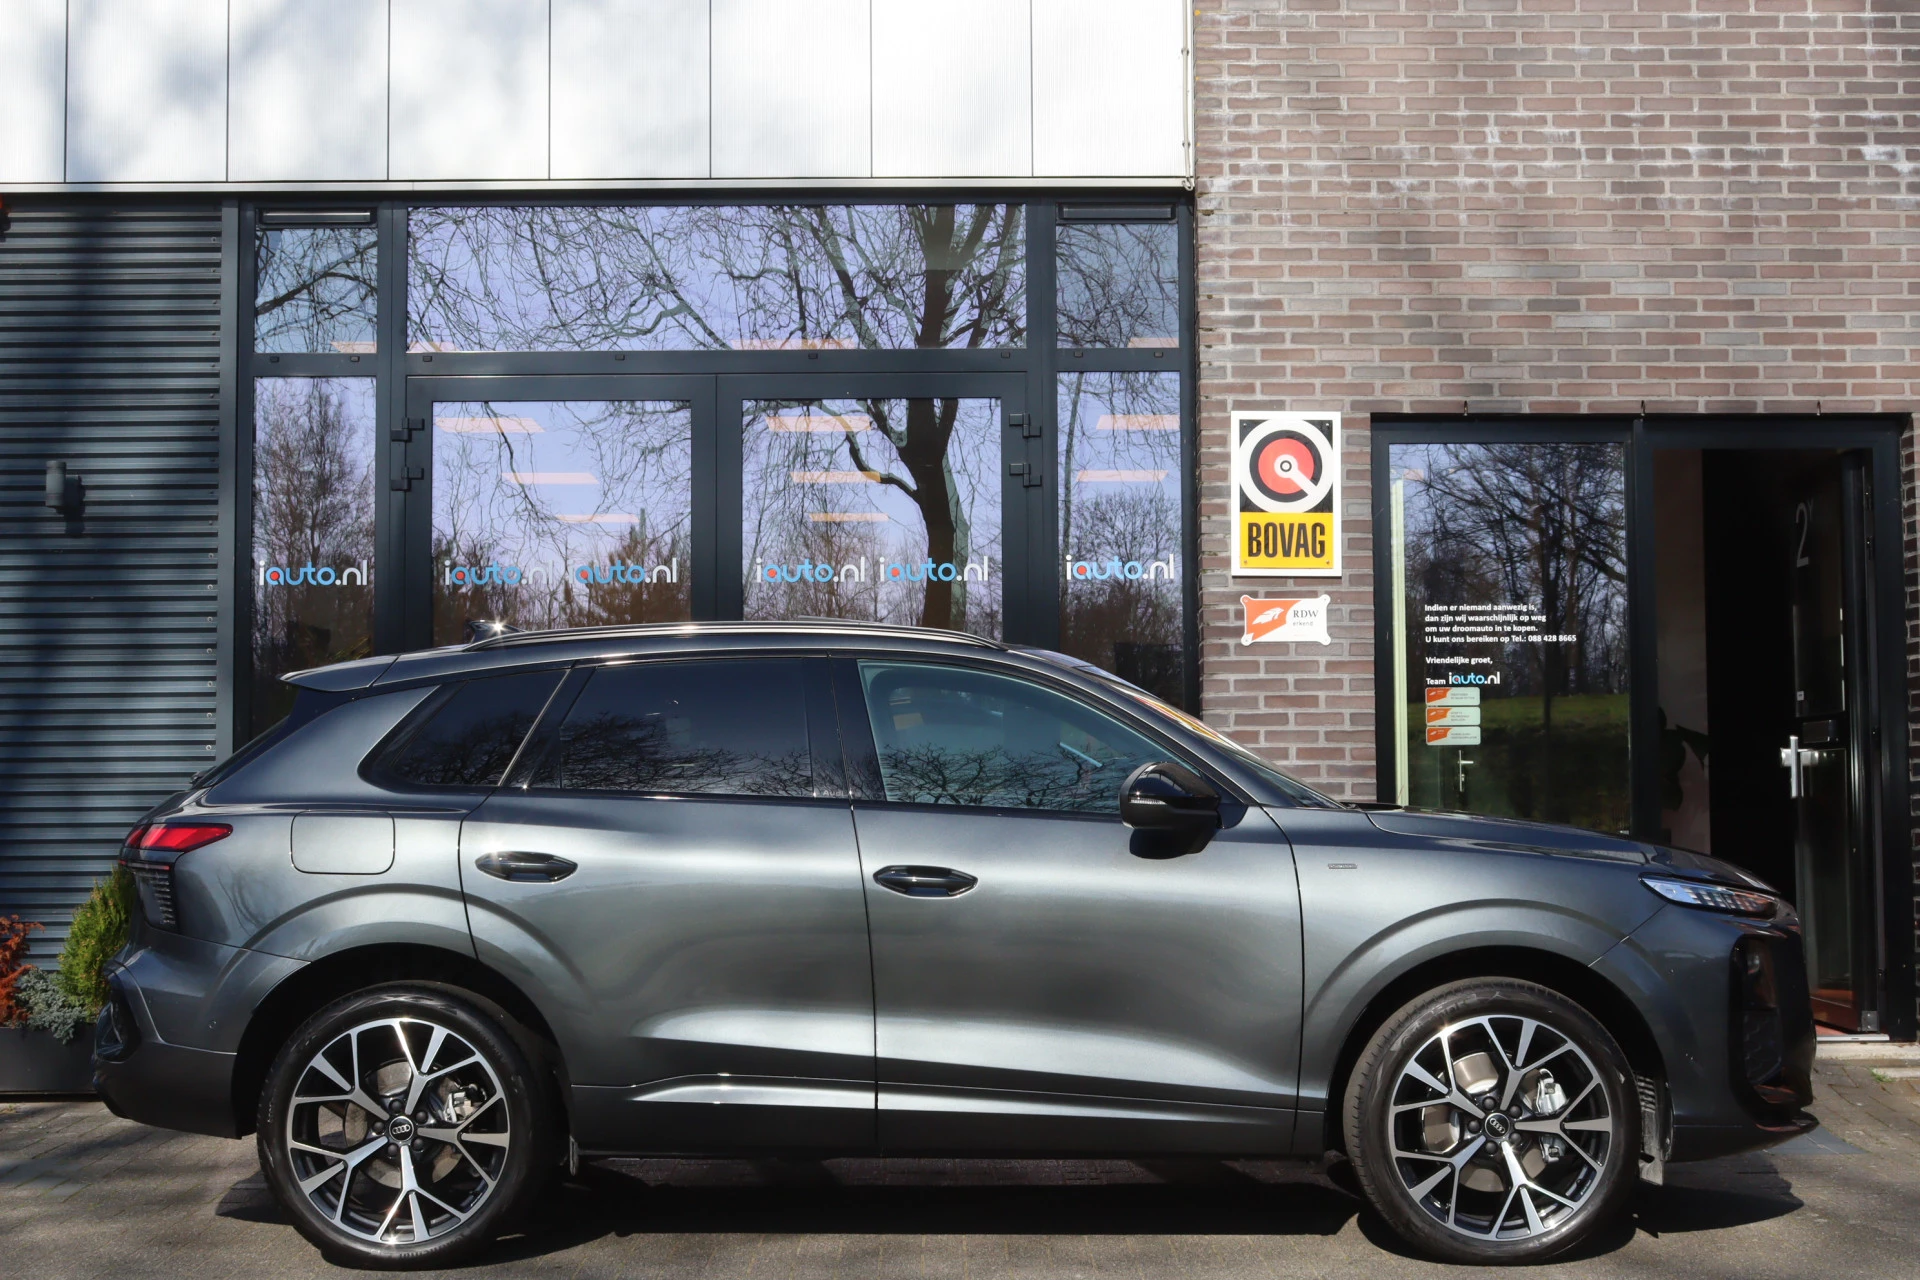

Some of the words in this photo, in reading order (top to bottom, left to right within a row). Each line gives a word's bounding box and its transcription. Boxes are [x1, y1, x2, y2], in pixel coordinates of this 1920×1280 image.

[1248, 522, 1325, 558] BOVAG
[259, 559, 368, 586] iauto.nl
[444, 559, 553, 585] iauto.nl
[755, 556, 866, 583] iauto.nl
[879, 555, 989, 582] iauto.nl
[1065, 553, 1175, 580] iauto.nl
[1293, 609, 1319, 618] RDW
[1441, 614, 1454, 623] zijn
[1455, 614, 1466, 623] wij
[1468, 614, 1518, 622] waarschijnlijk
[1493, 604, 1527, 612] aanwezig
[1425, 656, 1469, 665] Vriendelijke
[1470, 657, 1493, 665] groet,
[1448, 672, 1500, 684] iauto.nl
